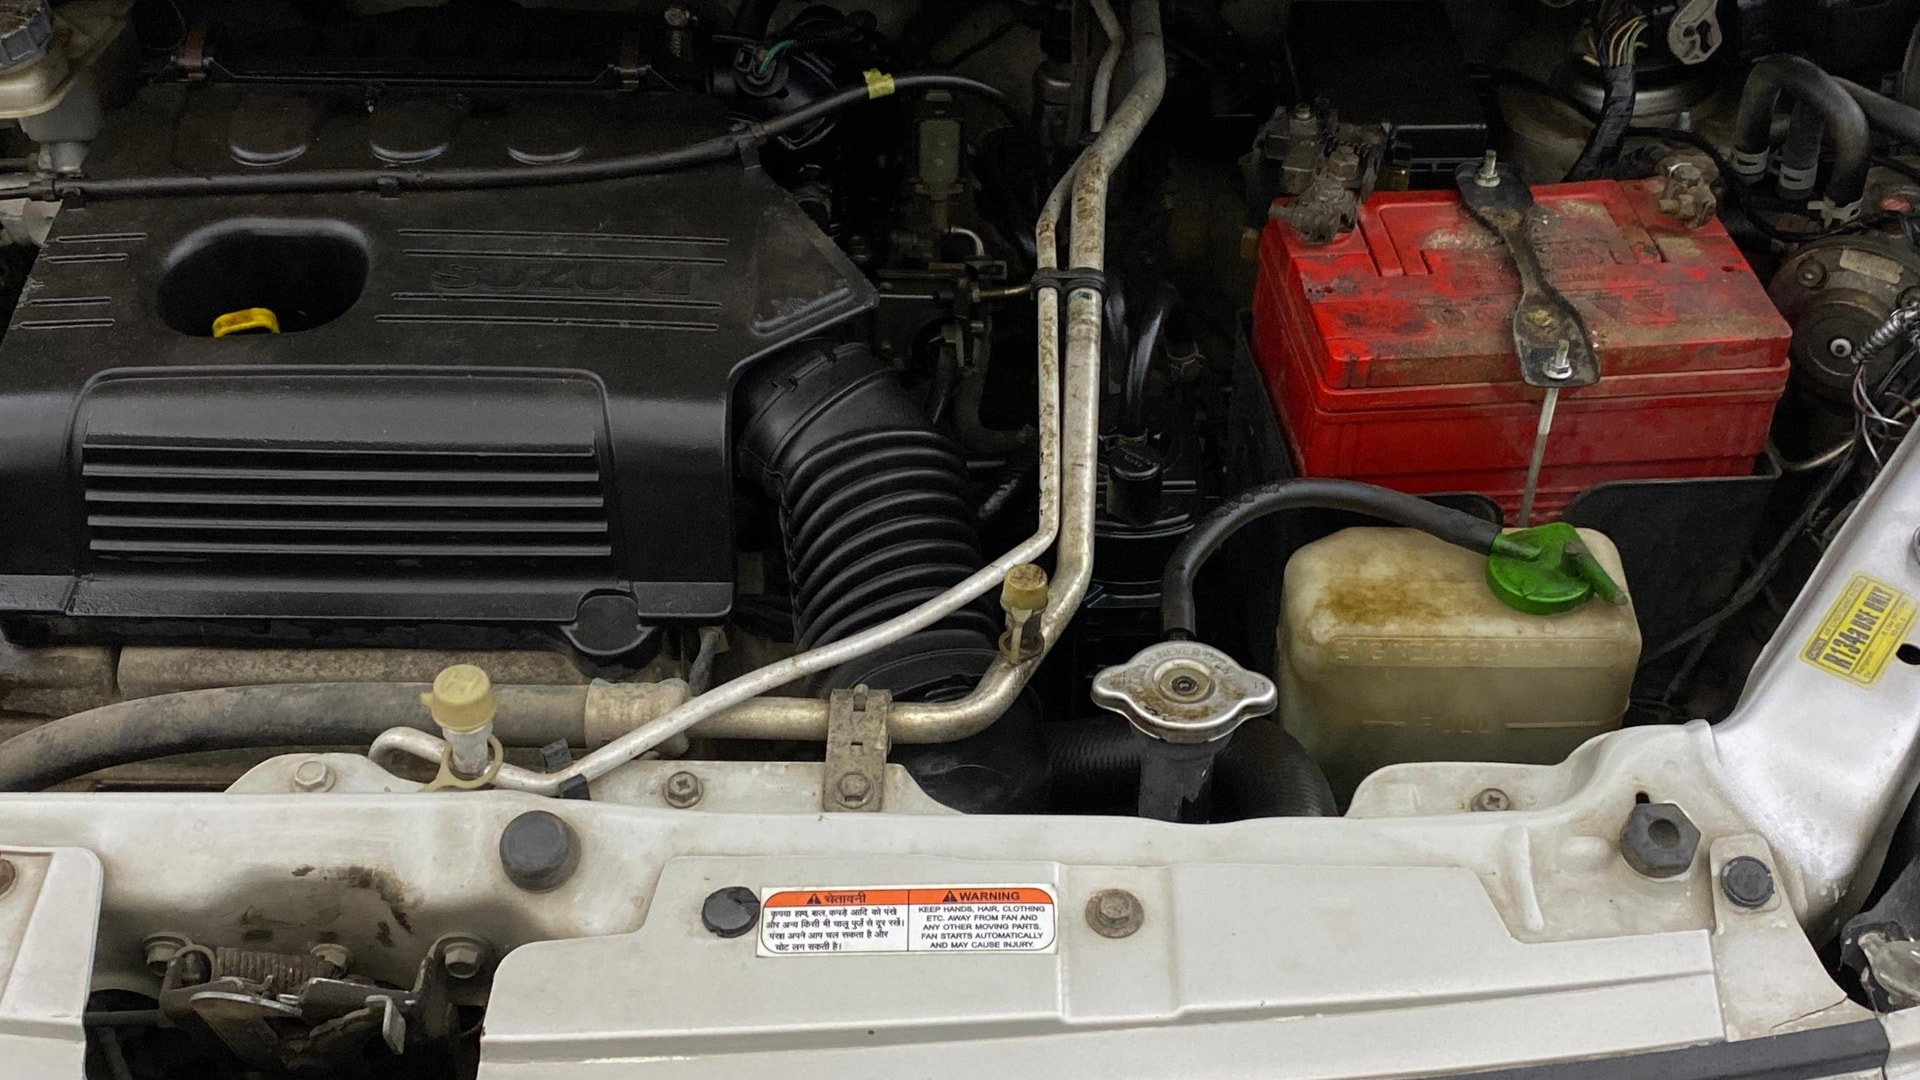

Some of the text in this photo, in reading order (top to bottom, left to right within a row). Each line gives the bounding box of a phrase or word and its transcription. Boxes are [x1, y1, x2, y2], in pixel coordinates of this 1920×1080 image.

[431, 262, 693, 296] SUZUKI
[825, 893, 866, 904] चेतावनी
[960, 892, 1020, 901] WARNING
[771, 910, 791, 921] कृपया
[850, 907, 867, 916] आदि
[872, 907, 881, 916] को
[766, 919, 779, 928] और
[788, 930, 805, 939] अपने
[808, 931, 823, 939] आप
[826, 931, 839, 939] चल
[842, 930, 864, 939] सकता
[867, 930, 872, 939] है
[875, 930, 888, 938] और
[792, 943, 805, 951] लग
